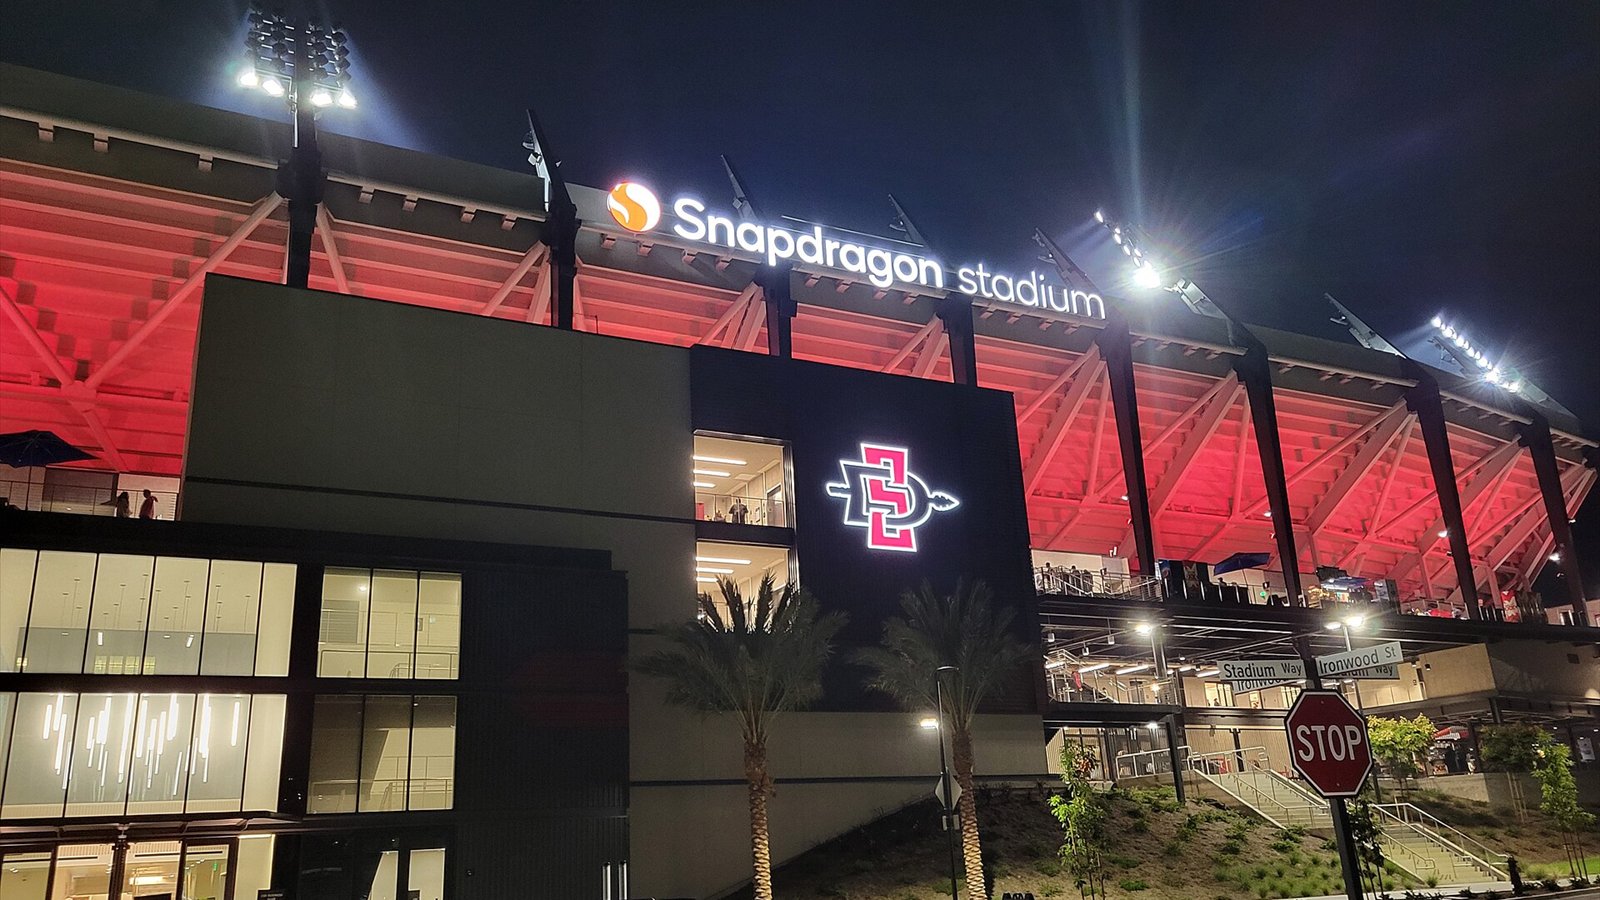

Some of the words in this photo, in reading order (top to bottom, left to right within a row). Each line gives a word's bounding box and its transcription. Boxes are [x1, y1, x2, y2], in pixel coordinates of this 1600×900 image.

[673, 198, 944, 288] Snapdragon
[958, 263, 1107, 320] stadium
[1223, 663, 1276, 678] Stadium
[1281, 662, 1302, 676] Way
[1319, 649, 1379, 674] Ironwood
[1384, 646, 1396, 658] St
[1296, 725, 1362, 761] STOP
